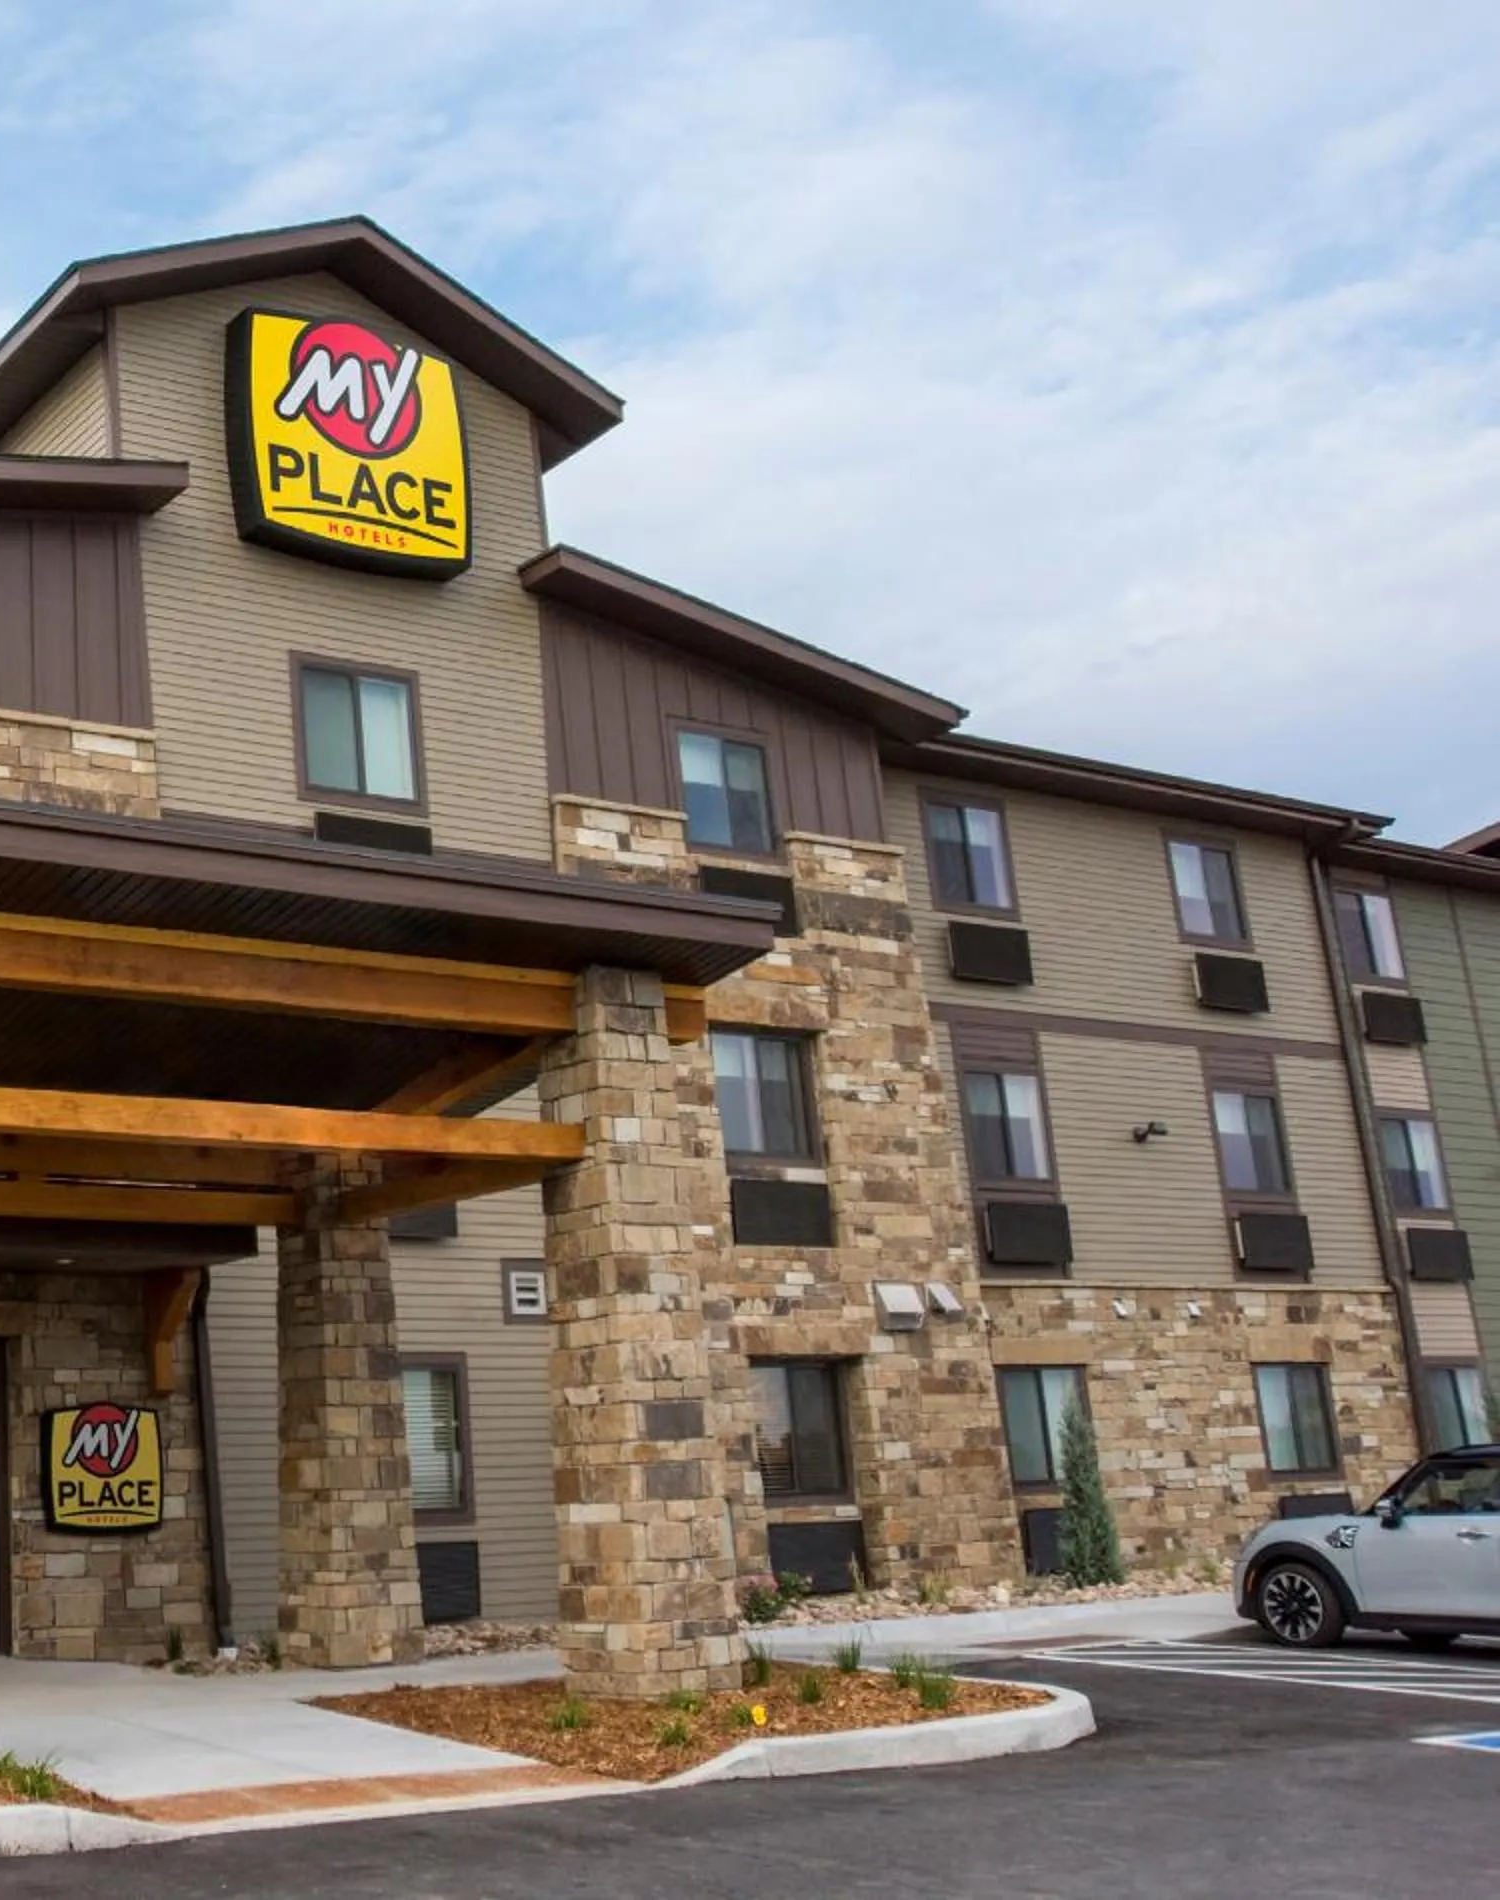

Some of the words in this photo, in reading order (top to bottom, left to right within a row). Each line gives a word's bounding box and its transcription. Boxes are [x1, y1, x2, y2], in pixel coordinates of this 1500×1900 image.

[268, 443, 456, 529] PLACE
[328, 521, 408, 548] HOTELS
[58, 1480, 156, 1507] PLACE
